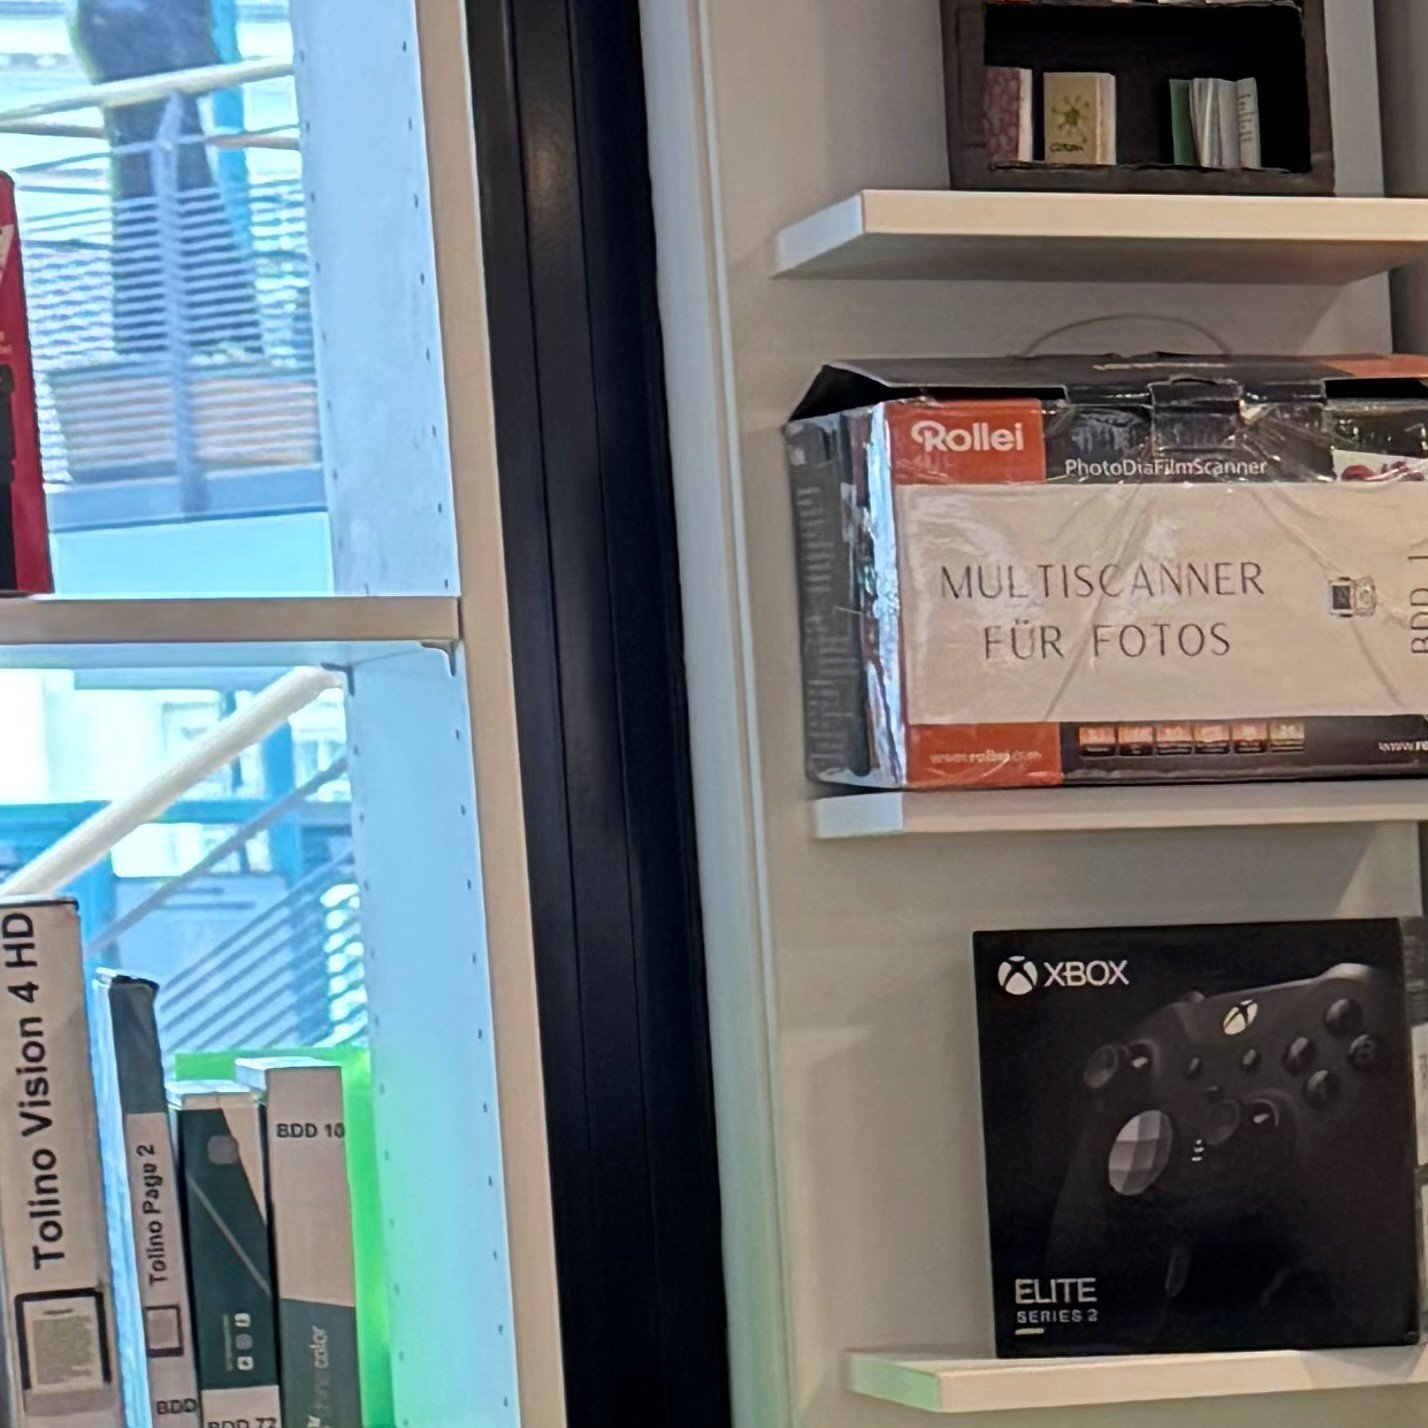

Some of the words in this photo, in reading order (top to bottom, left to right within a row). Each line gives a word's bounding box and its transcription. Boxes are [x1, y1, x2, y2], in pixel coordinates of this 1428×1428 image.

[909, 420, 1026, 453] Rollei
[1065, 456, 1268, 478] PhotoDiaFilmScanner
[940, 560, 1265, 601] MULTISCANNER
[983, 617, 1064, 661] FÜR
[1093, 621, 1232, 660] FOTOS
[2, 911, 38, 969] HD
[1043, 959, 1129, 988] XBOX
[8, 980, 39, 1003] 4
[16, 1016, 53, 1137] Vision
[276, 1124, 318, 1138] BDD
[136, 1143, 154, 1158] 2
[29, 1148, 66, 1270] Tolino
[147, 1218, 168, 1286] Tolino
[1015, 1277, 1098, 1306] ELITE
[1016, 1309, 1084, 1324] SERIES
[157, 1399, 197, 1414] BDD
